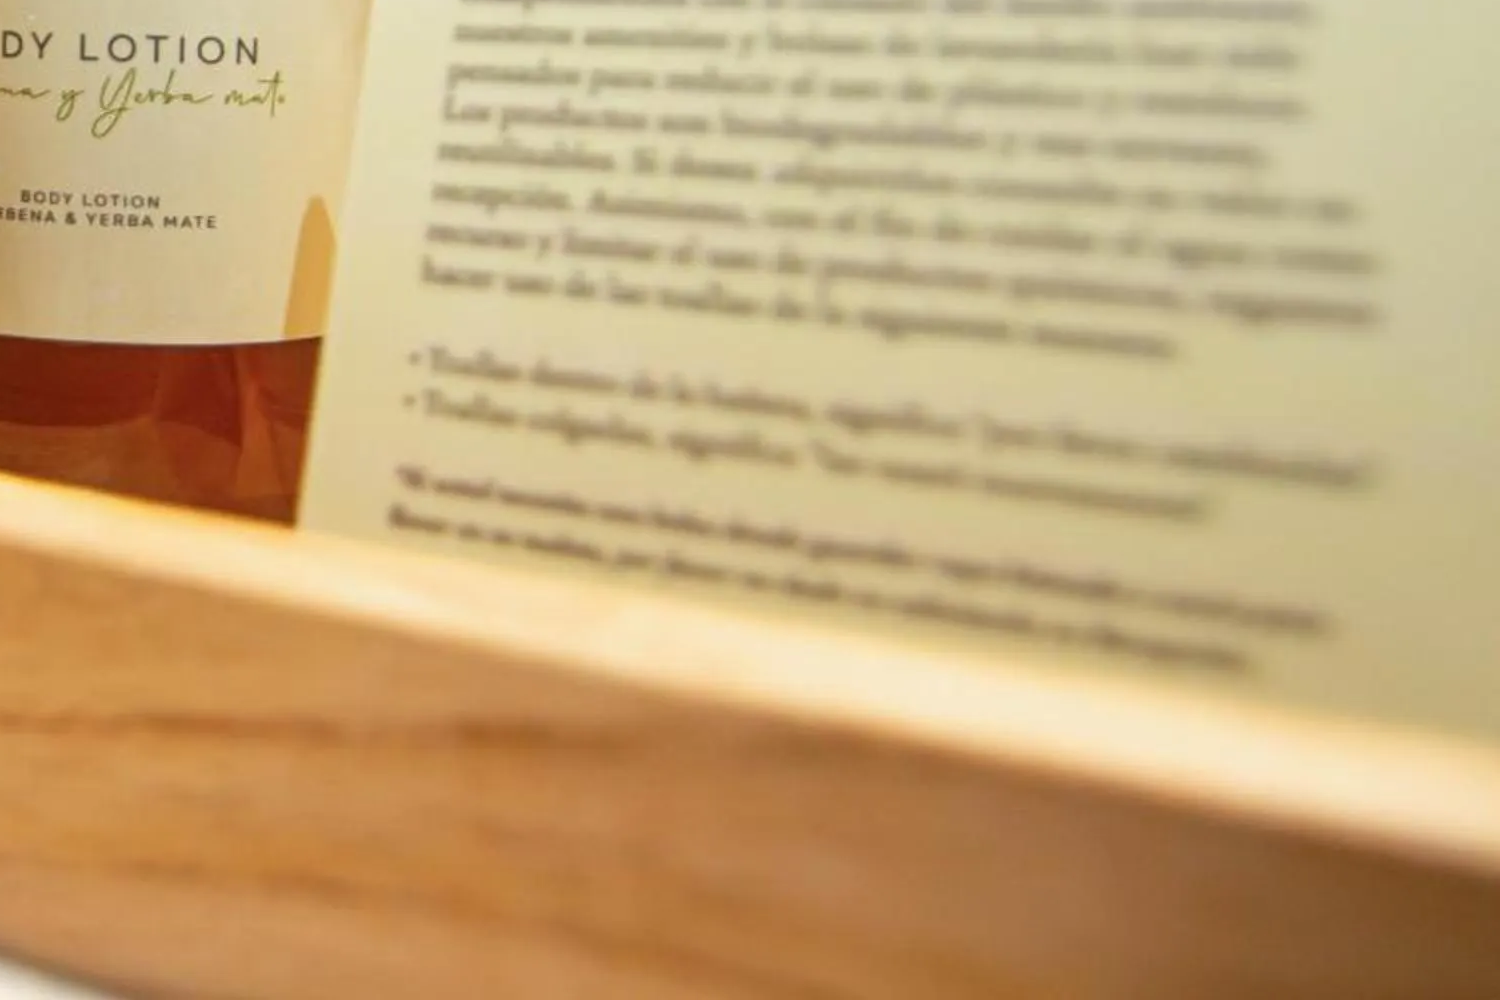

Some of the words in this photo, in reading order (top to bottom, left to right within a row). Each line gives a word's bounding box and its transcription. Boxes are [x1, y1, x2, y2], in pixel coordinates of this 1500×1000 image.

[79, 33, 260, 65] LOTION
[90, 67, 214, 139] Yerba
[20, 189, 74, 205] BODY
[82, 193, 161, 209] LOTION
[65, 212, 77, 225] &
[86, 213, 154, 228] YERBA
[163, 214, 218, 230] MATE
